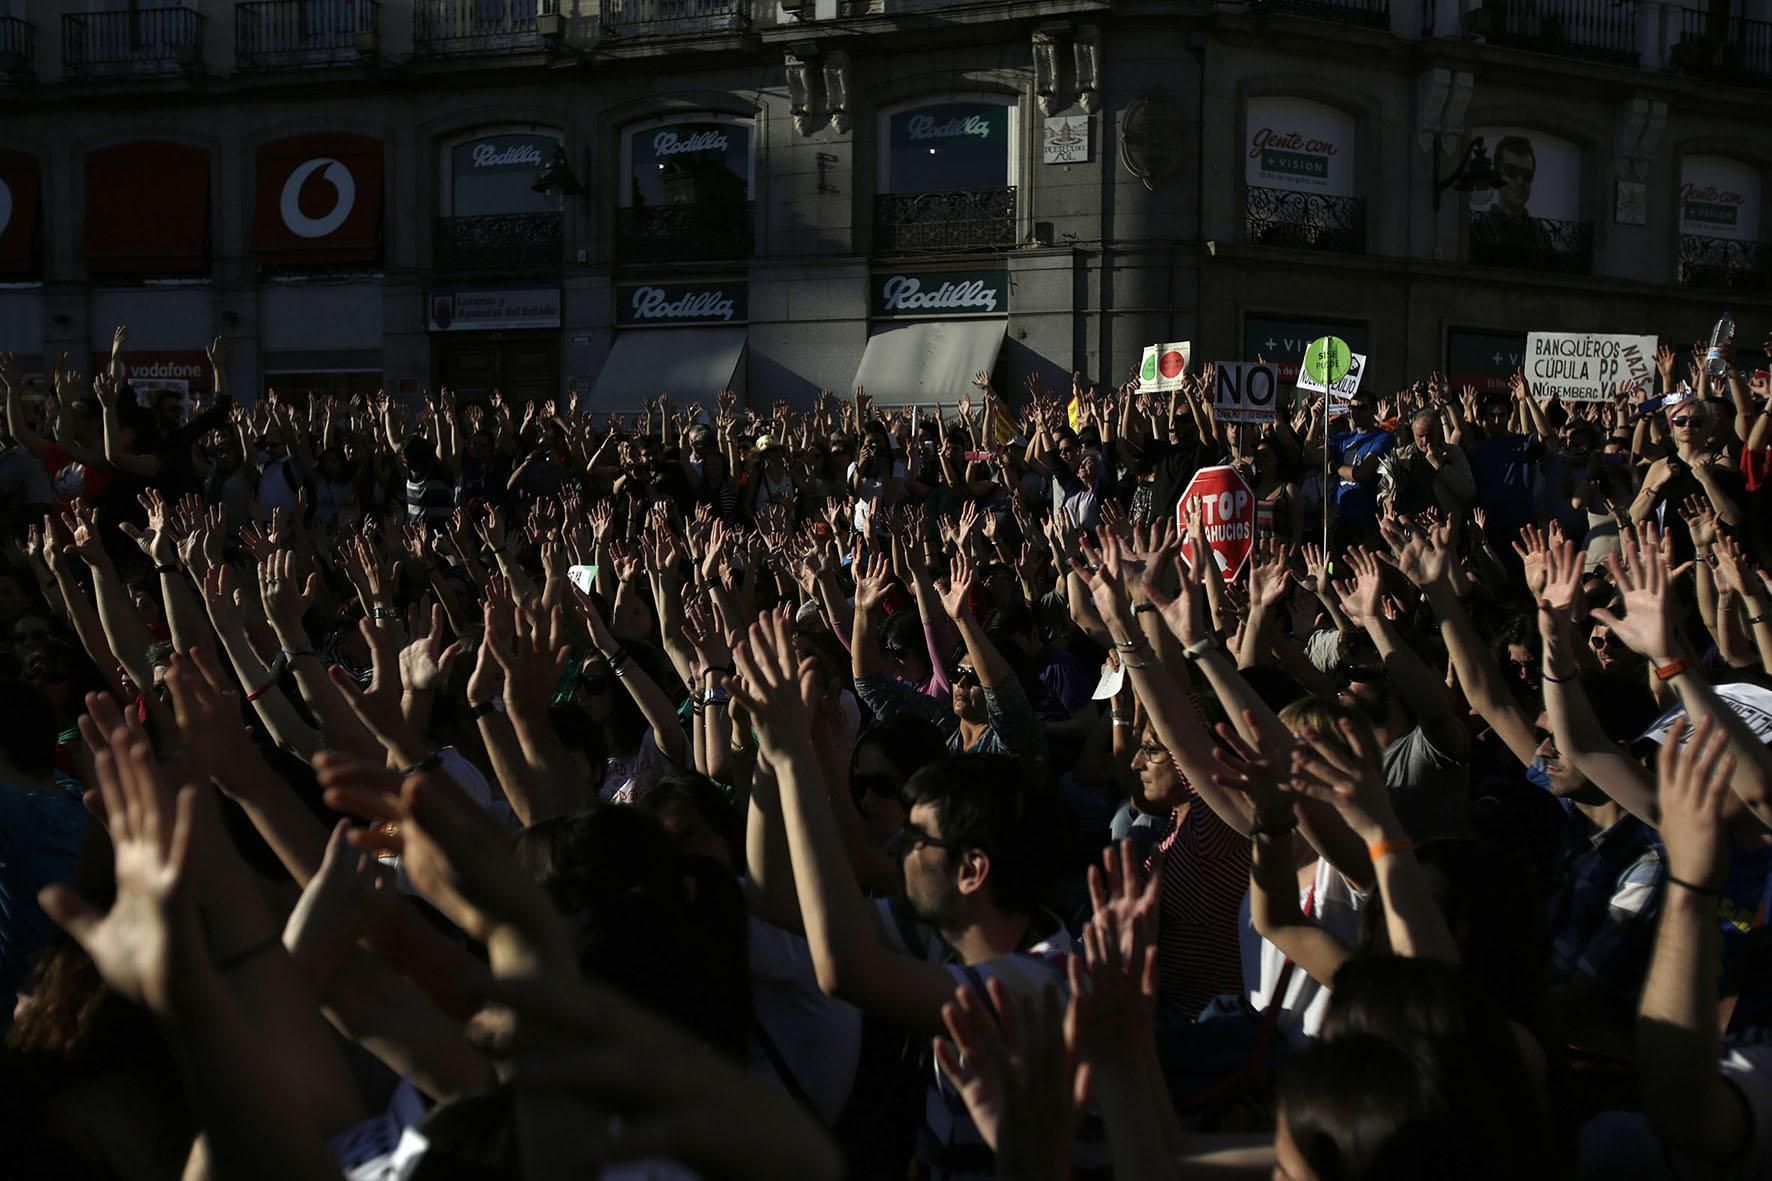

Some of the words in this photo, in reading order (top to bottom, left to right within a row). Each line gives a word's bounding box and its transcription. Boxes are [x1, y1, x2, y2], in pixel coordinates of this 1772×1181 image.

[909, 115, 990, 140] Rodilla
[472, 143, 541, 168] Rodilla
[654, 130, 728, 156] Rodilla
[1249, 128, 1304, 158] Gente
[1305, 139, 1338, 156] con
[1279, 157, 1323, 174] VISION
[632, 286, 734, 321] Rodilla
[883, 275, 998, 311] Rodilla
[130, 362, 201, 378] vodafone
[1534, 357, 1589, 380] CÚPULA
[1599, 359, 1619, 381] PP
[1217, 365, 1275, 406] NO
[1600, 381, 1617, 399] YA
[1186, 490, 1248, 525] TOP
